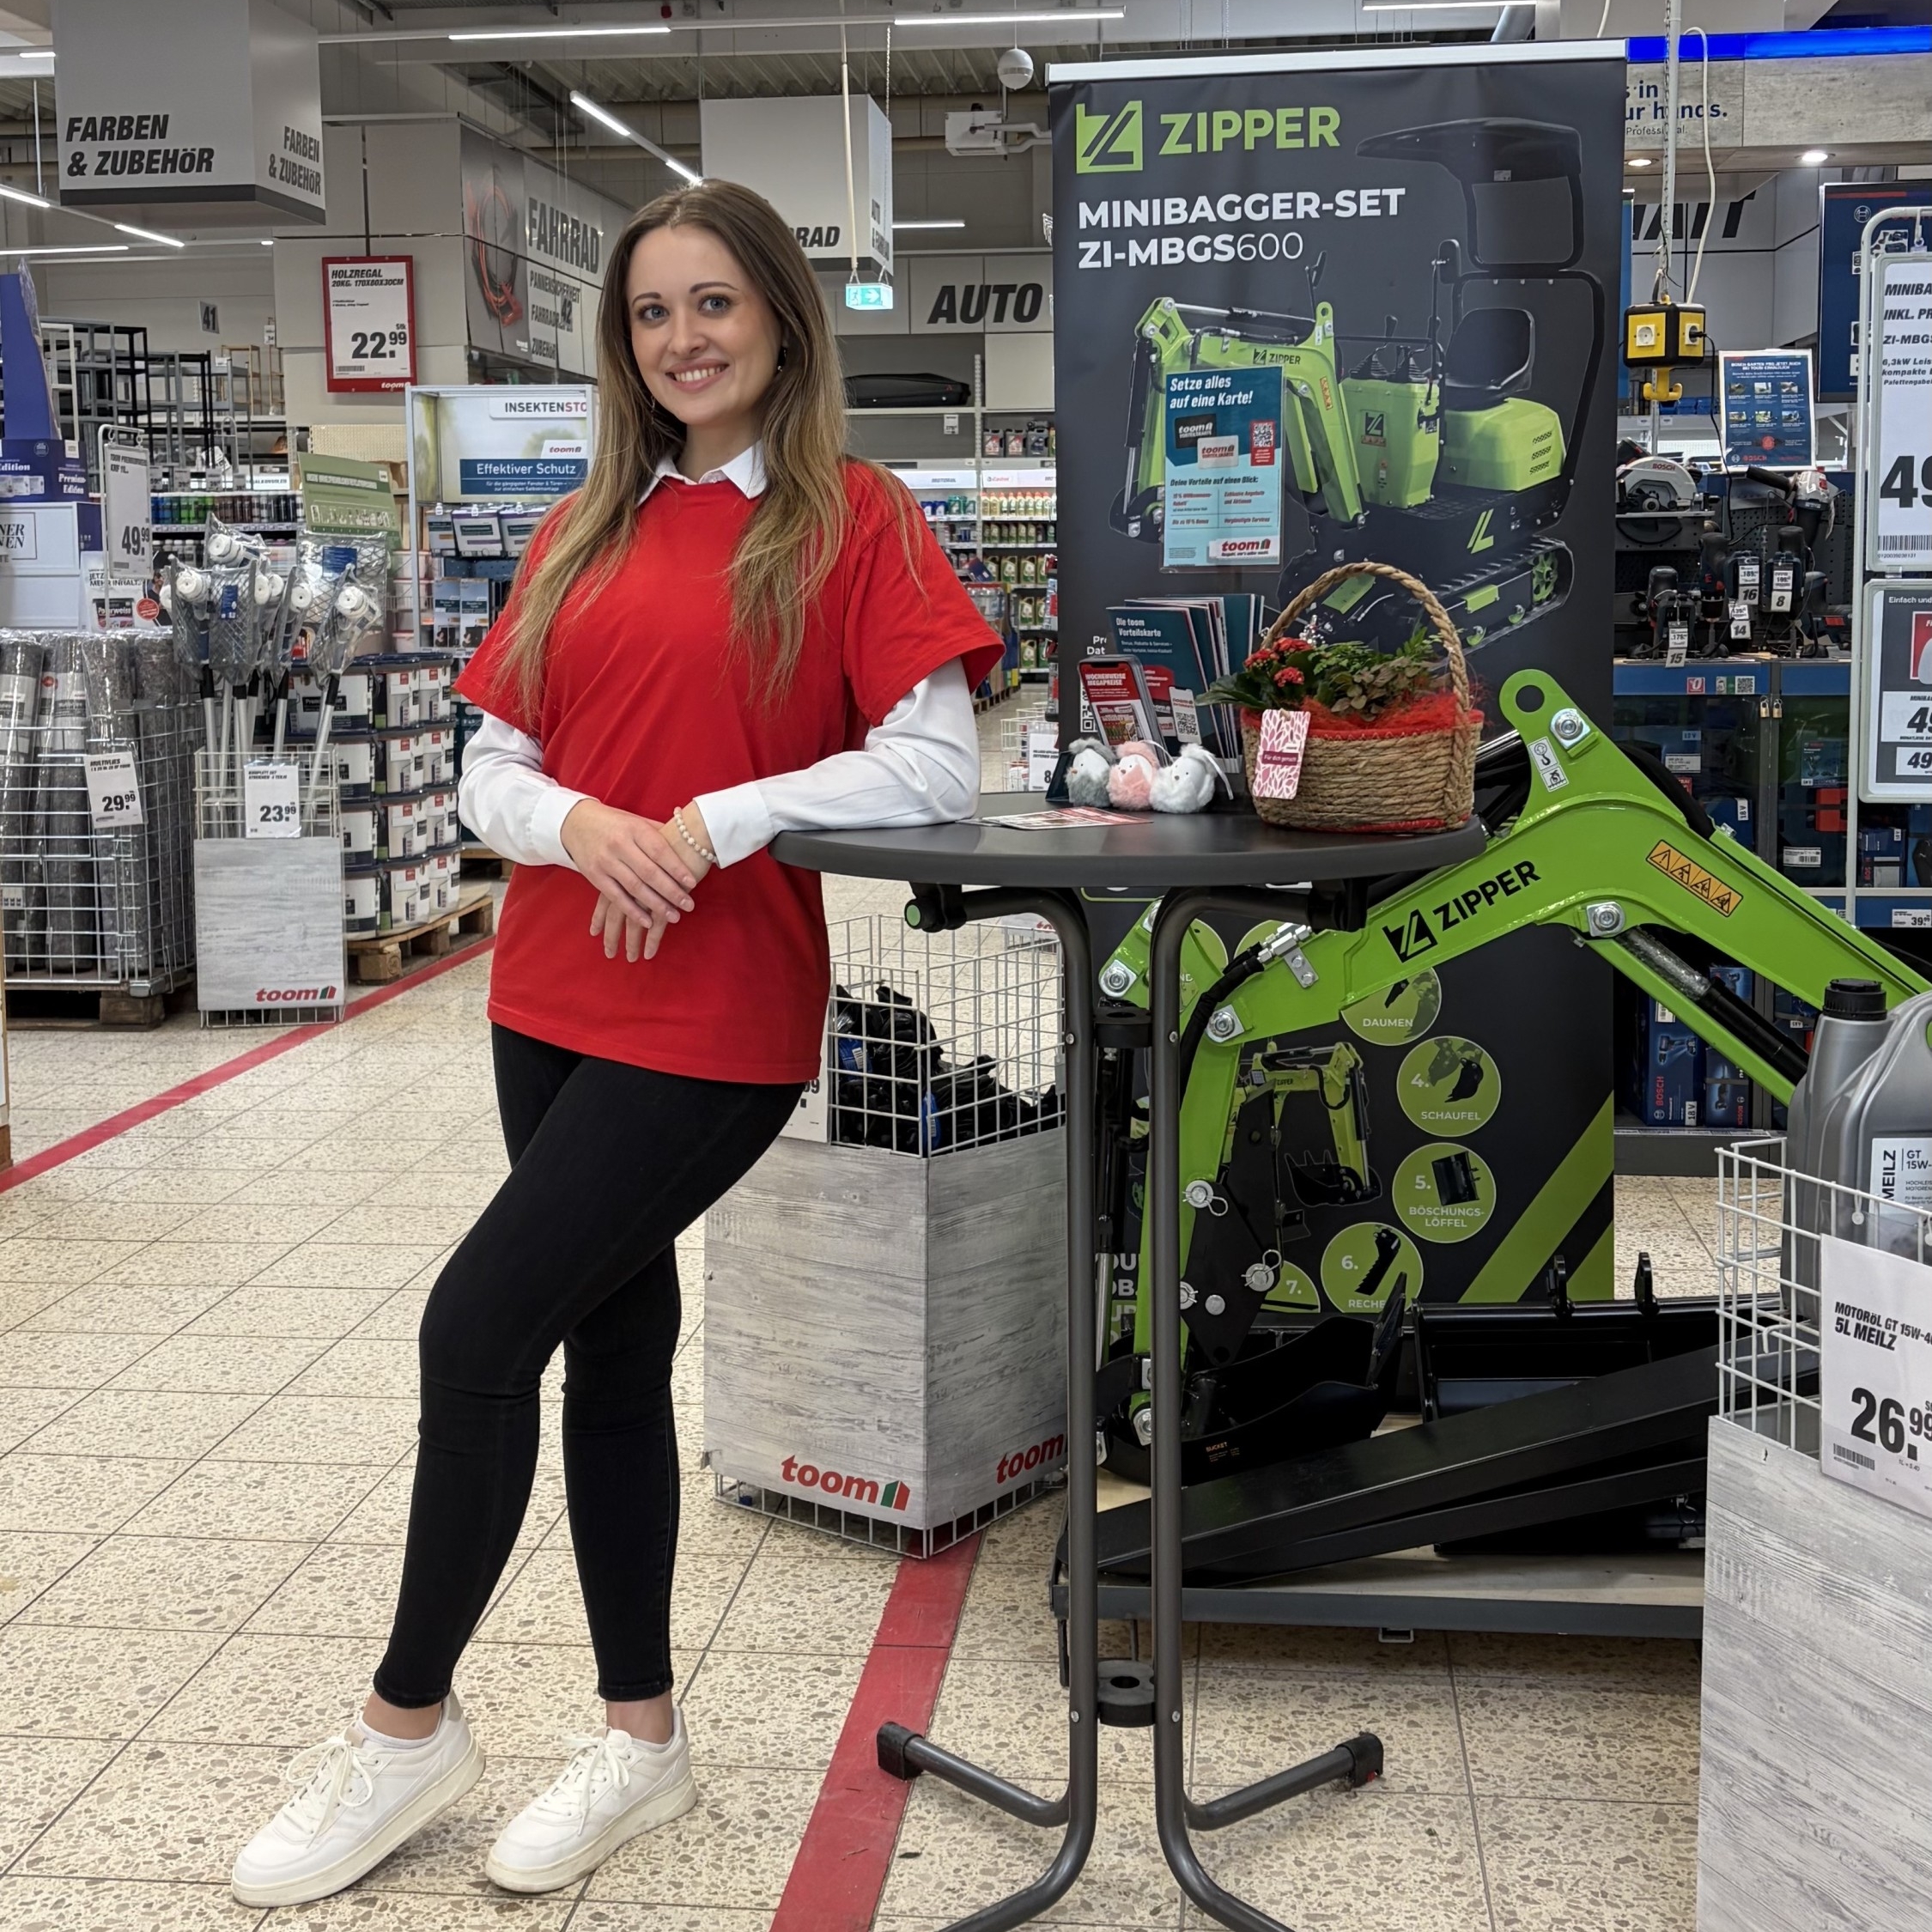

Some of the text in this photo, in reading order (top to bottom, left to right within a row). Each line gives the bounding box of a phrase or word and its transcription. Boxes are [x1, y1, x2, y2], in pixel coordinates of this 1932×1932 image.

[1638, 80, 1659, 99] in
[1653, 100, 1728, 120] hnds.
[65, 114, 170, 143] FARBEN
[1159, 106, 1340, 155] ZIPPER
[283, 125, 320, 163] FARBEN
[67, 152, 88, 177] &
[268, 154, 276, 179] &
[1078, 187, 1406, 229] MINIBAGGER-SET
[528, 197, 600, 275] FAHRRAD
[1078, 231, 1304, 270] ZI-MBGS600
[331, 269, 383, 279] HOLZREGAL
[560, 297, 573, 325] 42
[927, 283, 1043, 325] AUTO
[203, 306, 216, 331] 41
[1883, 309, 1915, 320] INKL.
[351, 331, 407, 359] 22.99
[1269, 353, 1301, 365] ZIPPER
[1881, 358, 1911, 367] 6,3kW
[1881, 368, 1926, 377] kompakte
[1170, 375, 1231, 392] Setze alles
[1170, 391, 1254, 409] auf eine Karte!
[1178, 424, 1205, 433] toom
[477, 464, 576, 475] Effektiver Schutz
[1170, 478, 1187, 487] Deine
[122, 526, 150, 556] 49.99
[1222, 540, 1260, 552] toom
[1742, 589, 1758, 601] 16
[1776, 595, 1785, 607] 8
[1116, 617, 1126, 626] Die
[1118, 628, 1162, 637] Vorteilskarte
[1734, 625, 1747, 636] 14
[1669, 653, 1683, 665] 15
[101, 793, 136, 812] 29.99
[259, 805, 296, 822] 23.99
[1432, 860, 1542, 932] ZIPPER
[255, 987, 319, 1003] toom
[1362, 1018, 1414, 1028] DAUMEN
[1411, 1073, 1430, 1088] 4.
[1655, 1076, 1665, 1107] BOSCH
[1421, 1111, 1481, 1121] SCHAUFEL
[1906, 1150, 1923, 1159] GT
[1414, 1175, 1431, 1190] 5.
[1881, 1150, 1897, 1201] MEILZ
[1408, 1206, 1485, 1218] BÖSCHUNGS-
[1425, 1216, 1468, 1228] LÖFFEL
[1341, 1255, 1359, 1271] 6.
[1285, 1279, 1302, 1295] 7.
[1834, 1301, 1899, 1332] MOTORÖL GT
[1834, 1316, 1898, 1352] 5L MEILZ
[996, 1433, 1064, 1485] toom
[781, 1454, 879, 1504] toom
